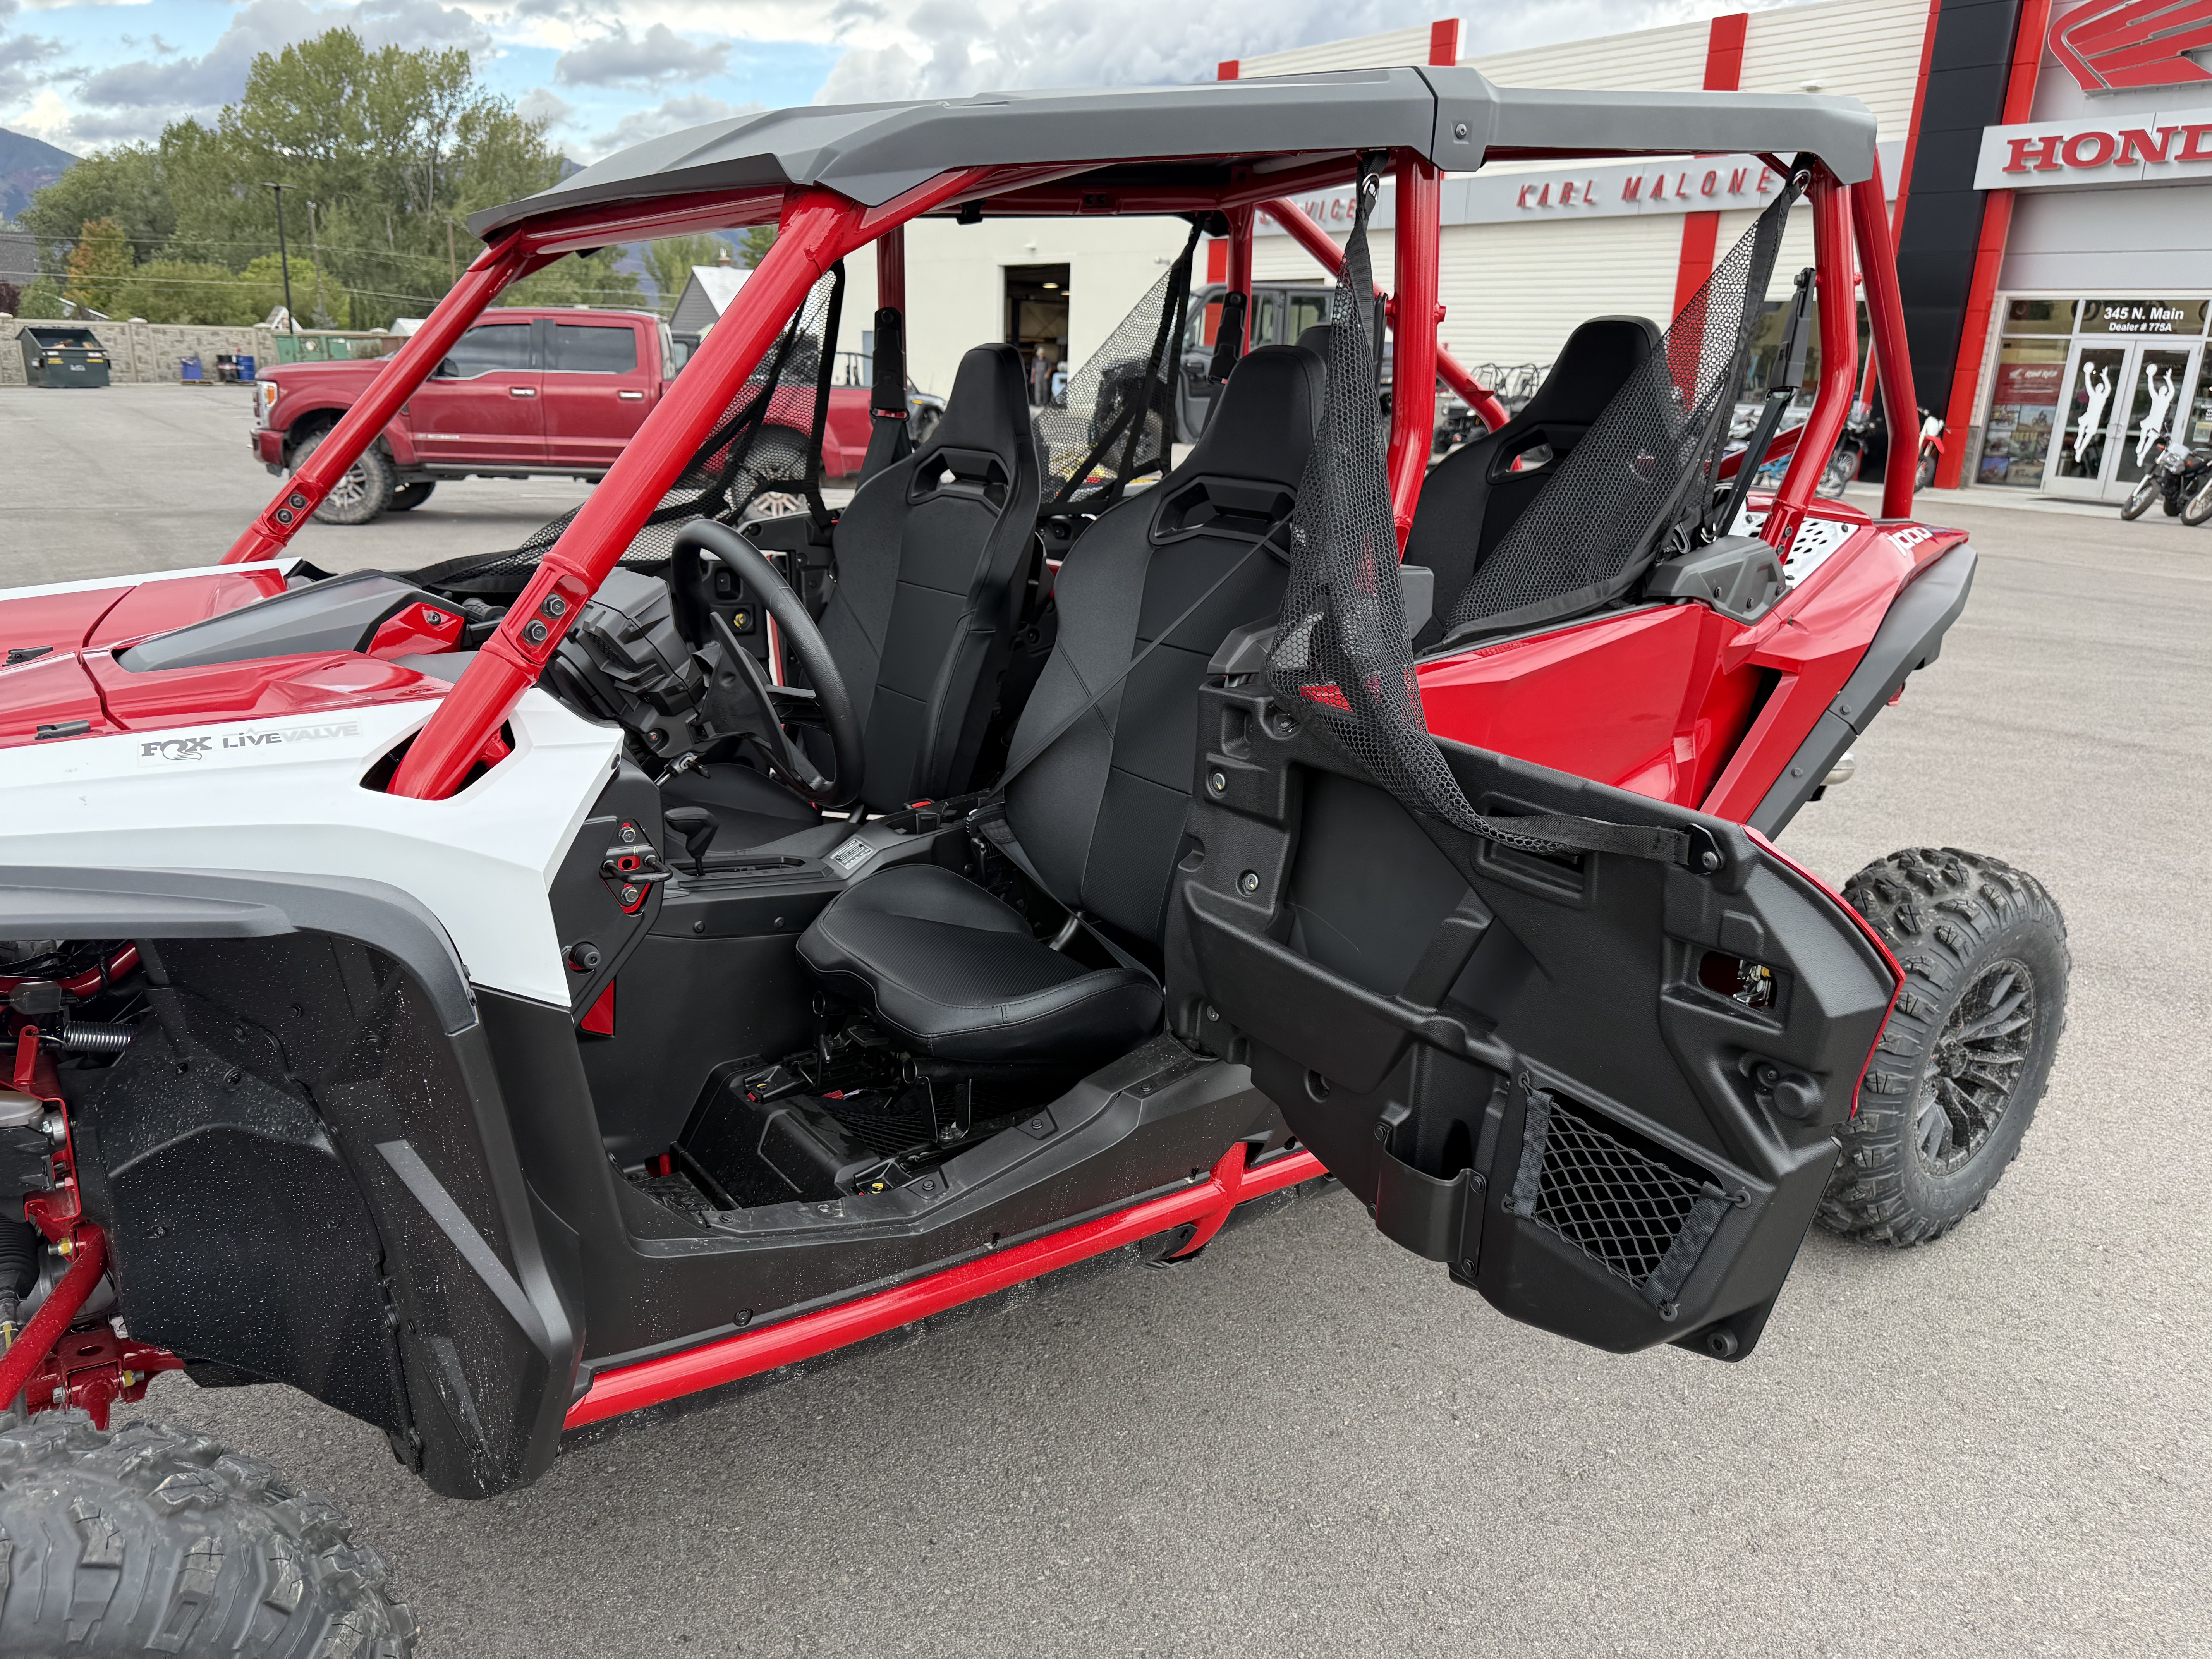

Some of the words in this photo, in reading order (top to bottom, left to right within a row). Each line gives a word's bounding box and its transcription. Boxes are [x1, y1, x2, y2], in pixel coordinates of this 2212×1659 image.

[1516, 179, 1593, 207] KARL
[1621, 167, 1772, 201] MALONE
[1258, 198, 1357, 225] SVICE
[2104, 307, 2129, 319] 345
[2131, 307, 2146, 320] N.
[2150, 307, 2184, 320] Main
[2109, 322, 2139, 331] Dealer
[2140, 322, 2148, 331] #
[2149, 323, 2172, 332] 775A
[1886, 526, 1933, 557] 1000
[141, 736, 212, 761] FOX
